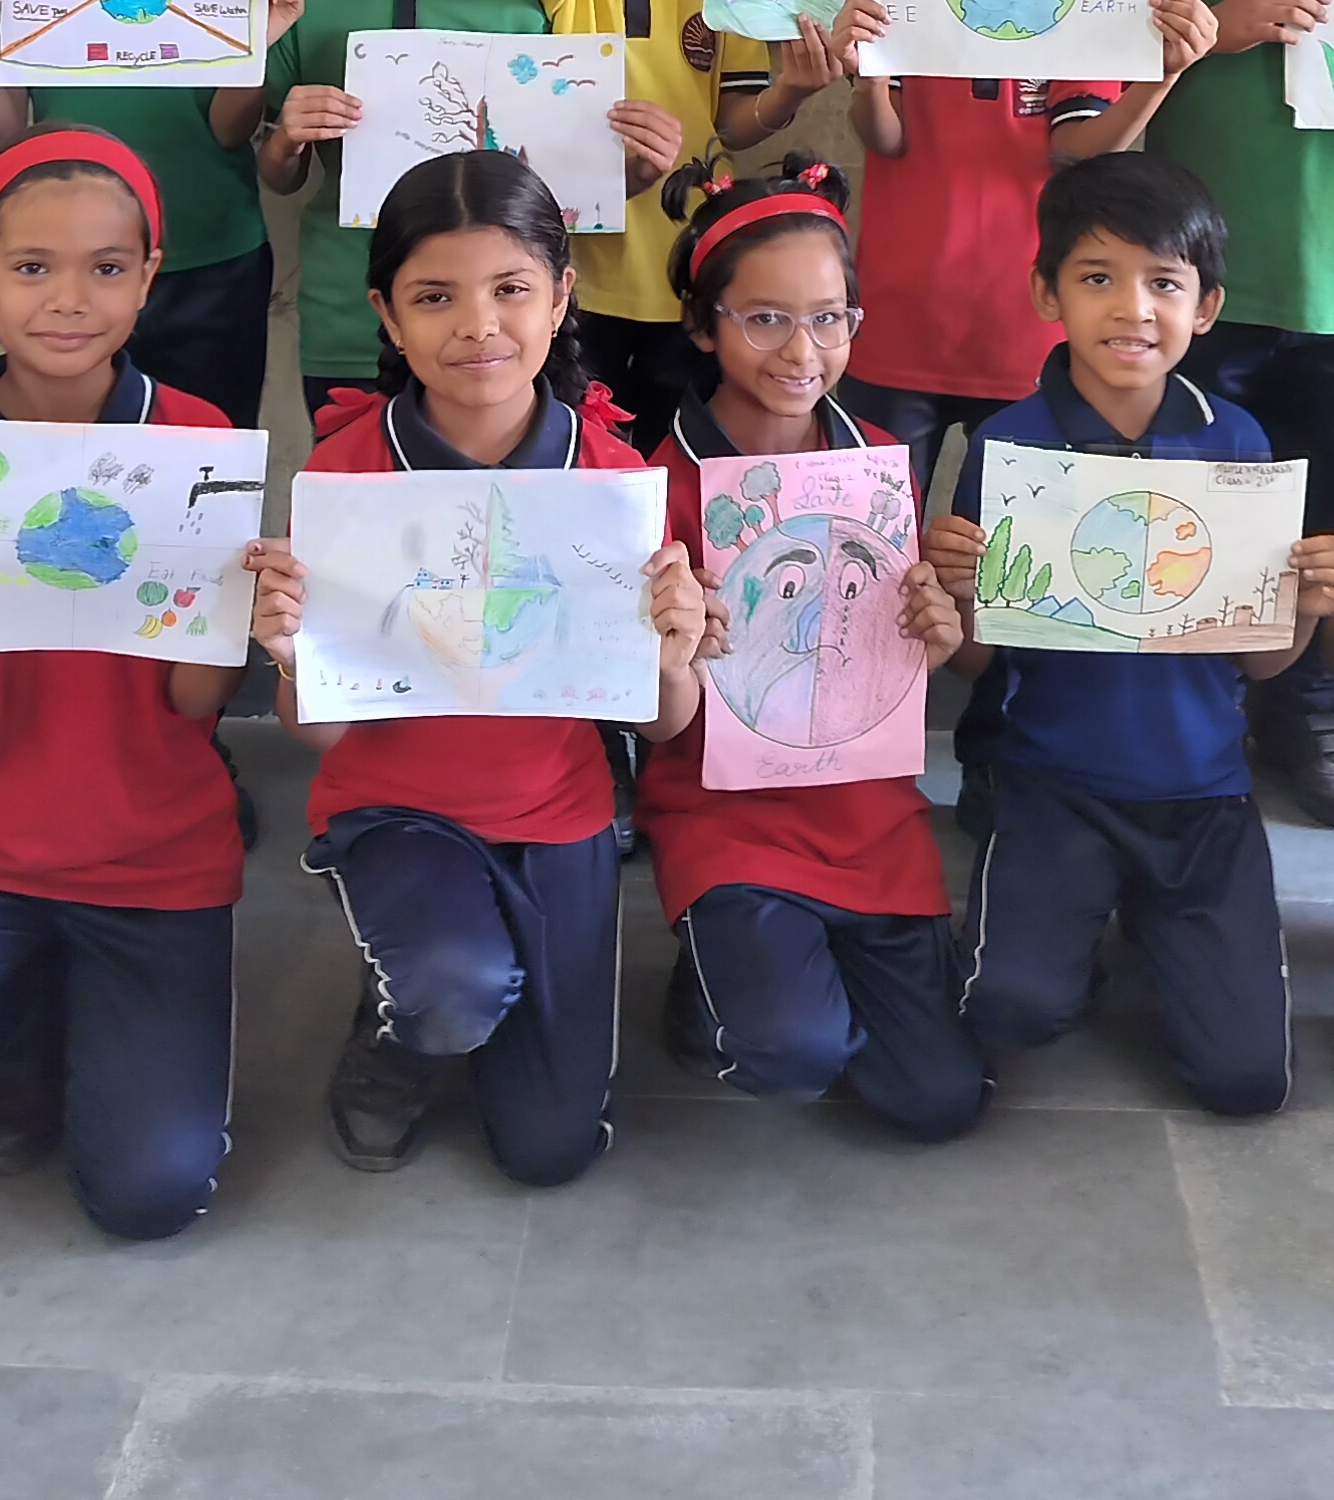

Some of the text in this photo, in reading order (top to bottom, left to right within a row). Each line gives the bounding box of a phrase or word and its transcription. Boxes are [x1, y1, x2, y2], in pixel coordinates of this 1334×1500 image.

[13, 0, 50, 17] SAVE
[194, 2, 218, 14] SAVE
[1080, 0, 1138, 15] EARTH
[755, 751, 844, 779] Earth
